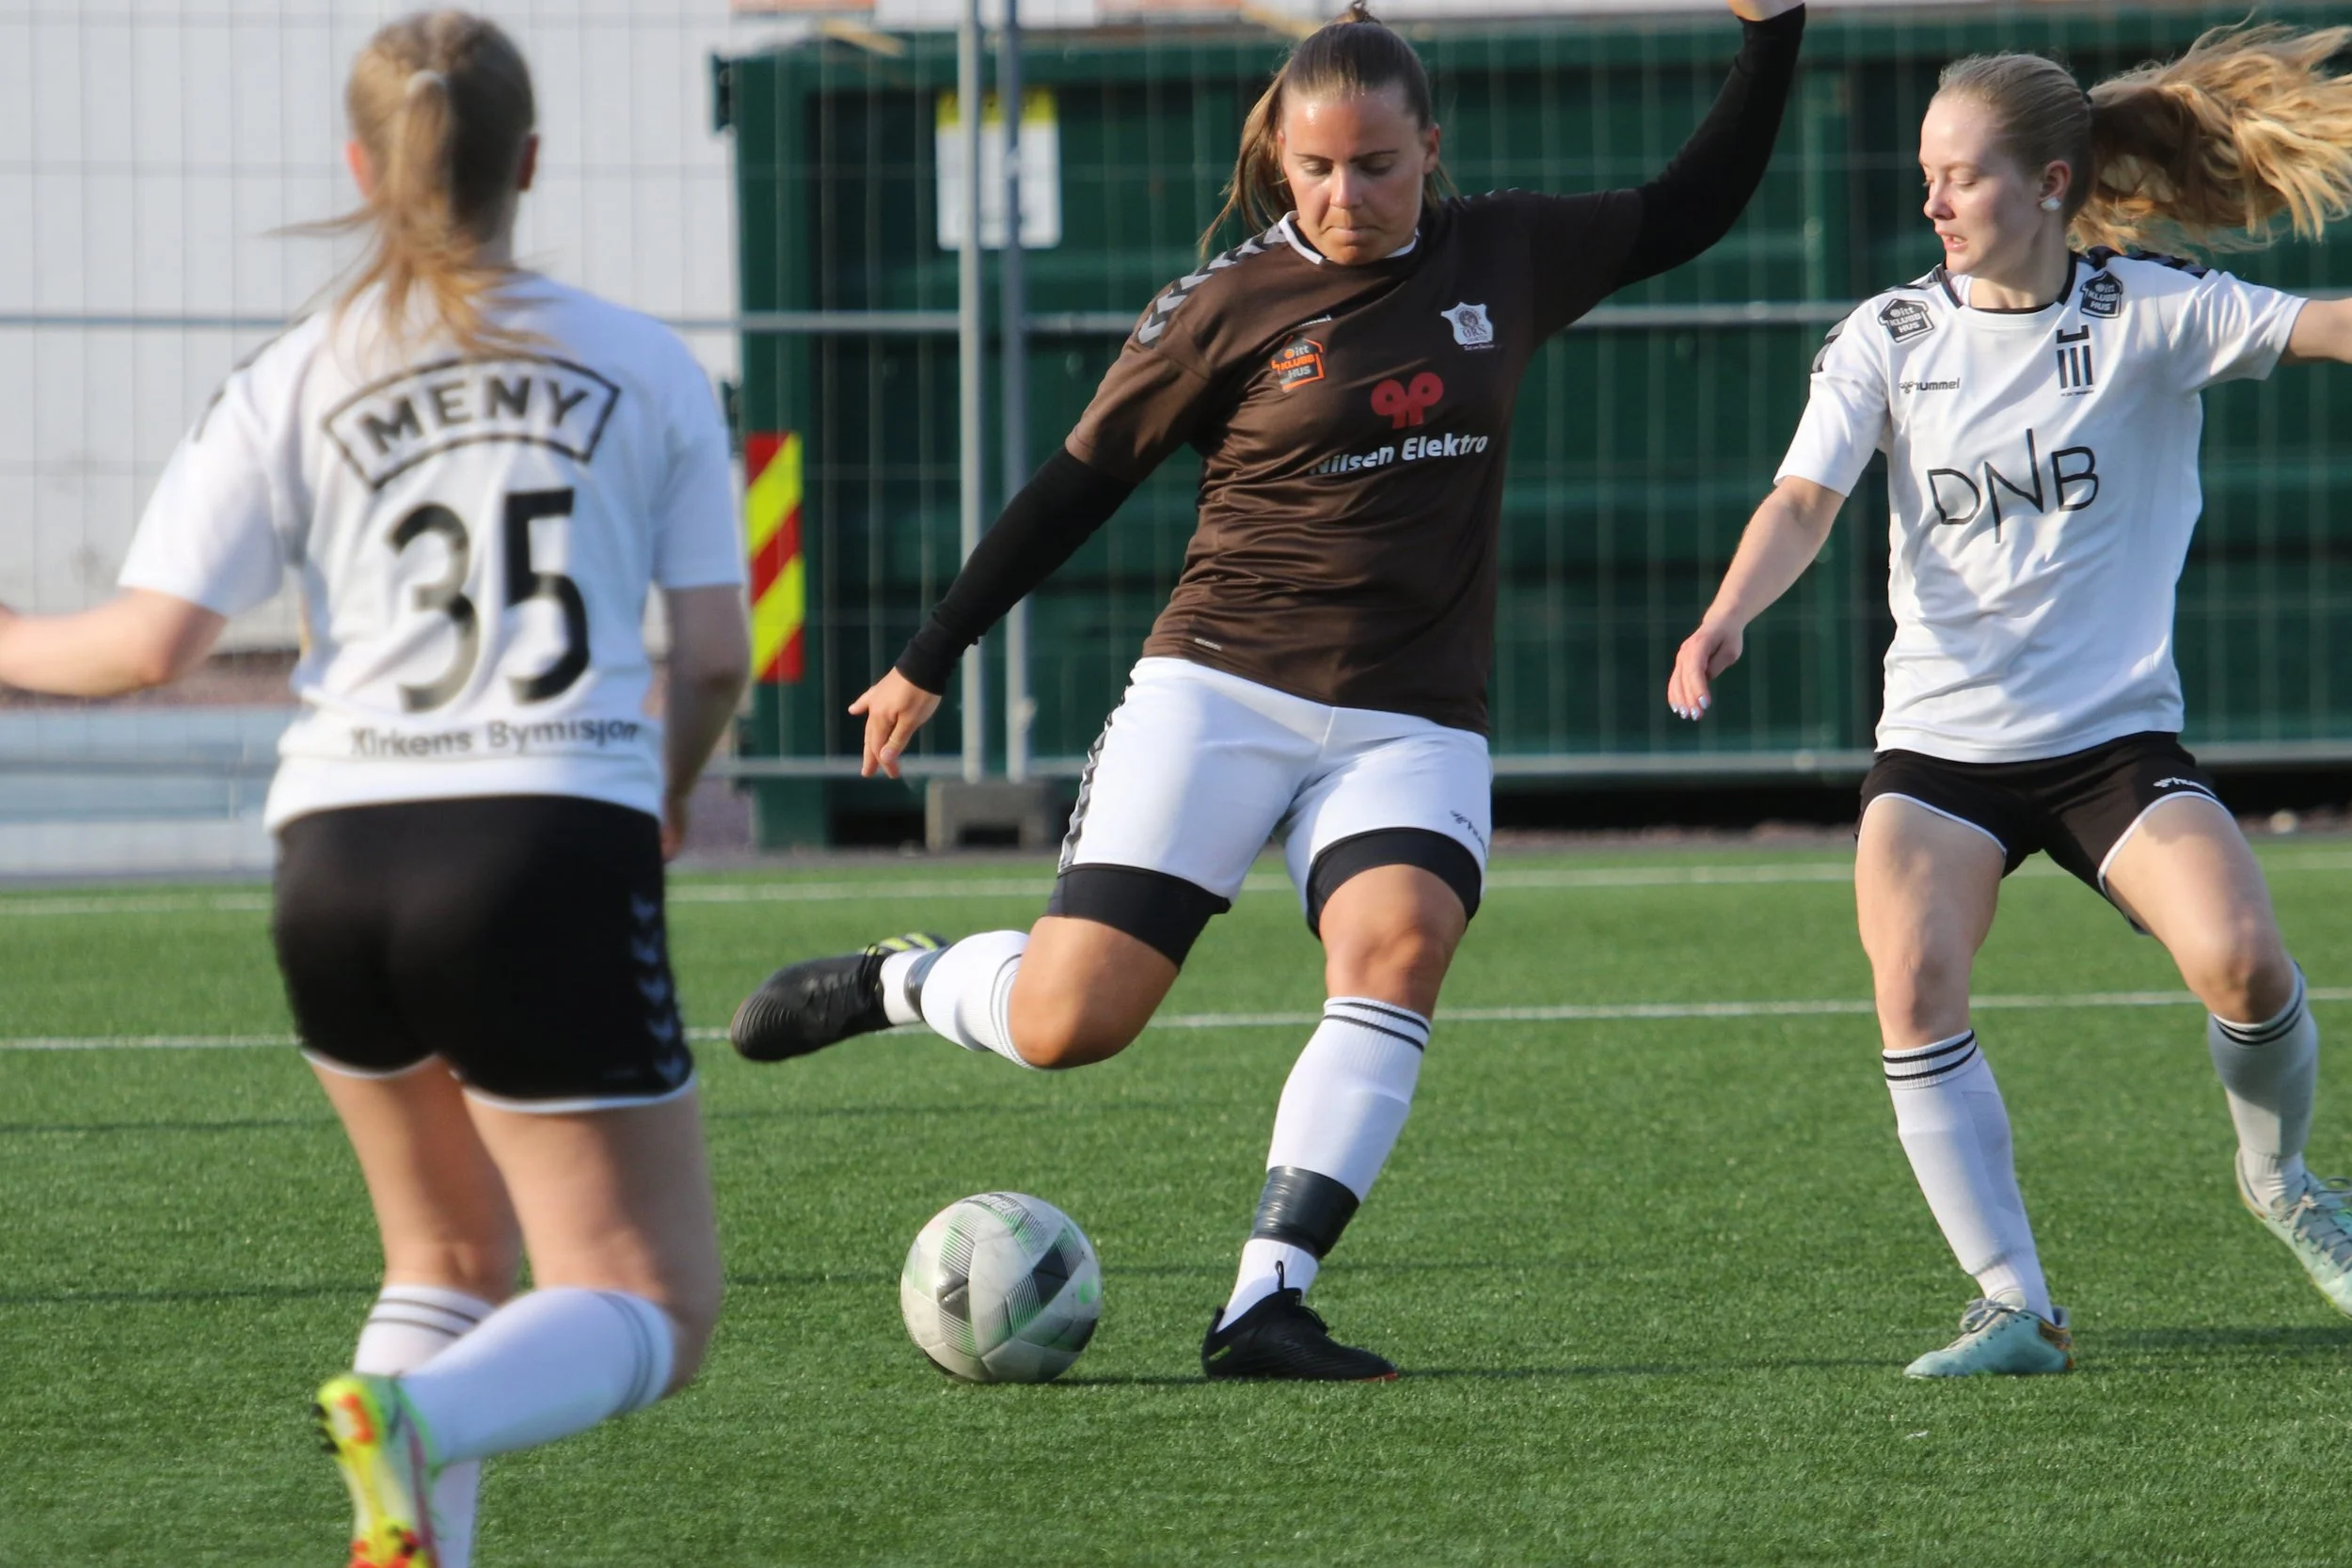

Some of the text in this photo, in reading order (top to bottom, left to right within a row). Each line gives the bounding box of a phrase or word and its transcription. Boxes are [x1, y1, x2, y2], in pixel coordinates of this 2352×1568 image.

[2090, 301, 2111, 310] HUS
[1889, 313, 1921, 326] KLUBB
[1898, 322, 1920, 333] HUS
[1287, 366, 1311, 378] HUS
[359, 378, 589, 455] MENY
[1401, 433, 1488, 461] Elektro
[1927, 429, 2099, 543] DNB
[388, 487, 590, 714] 35
